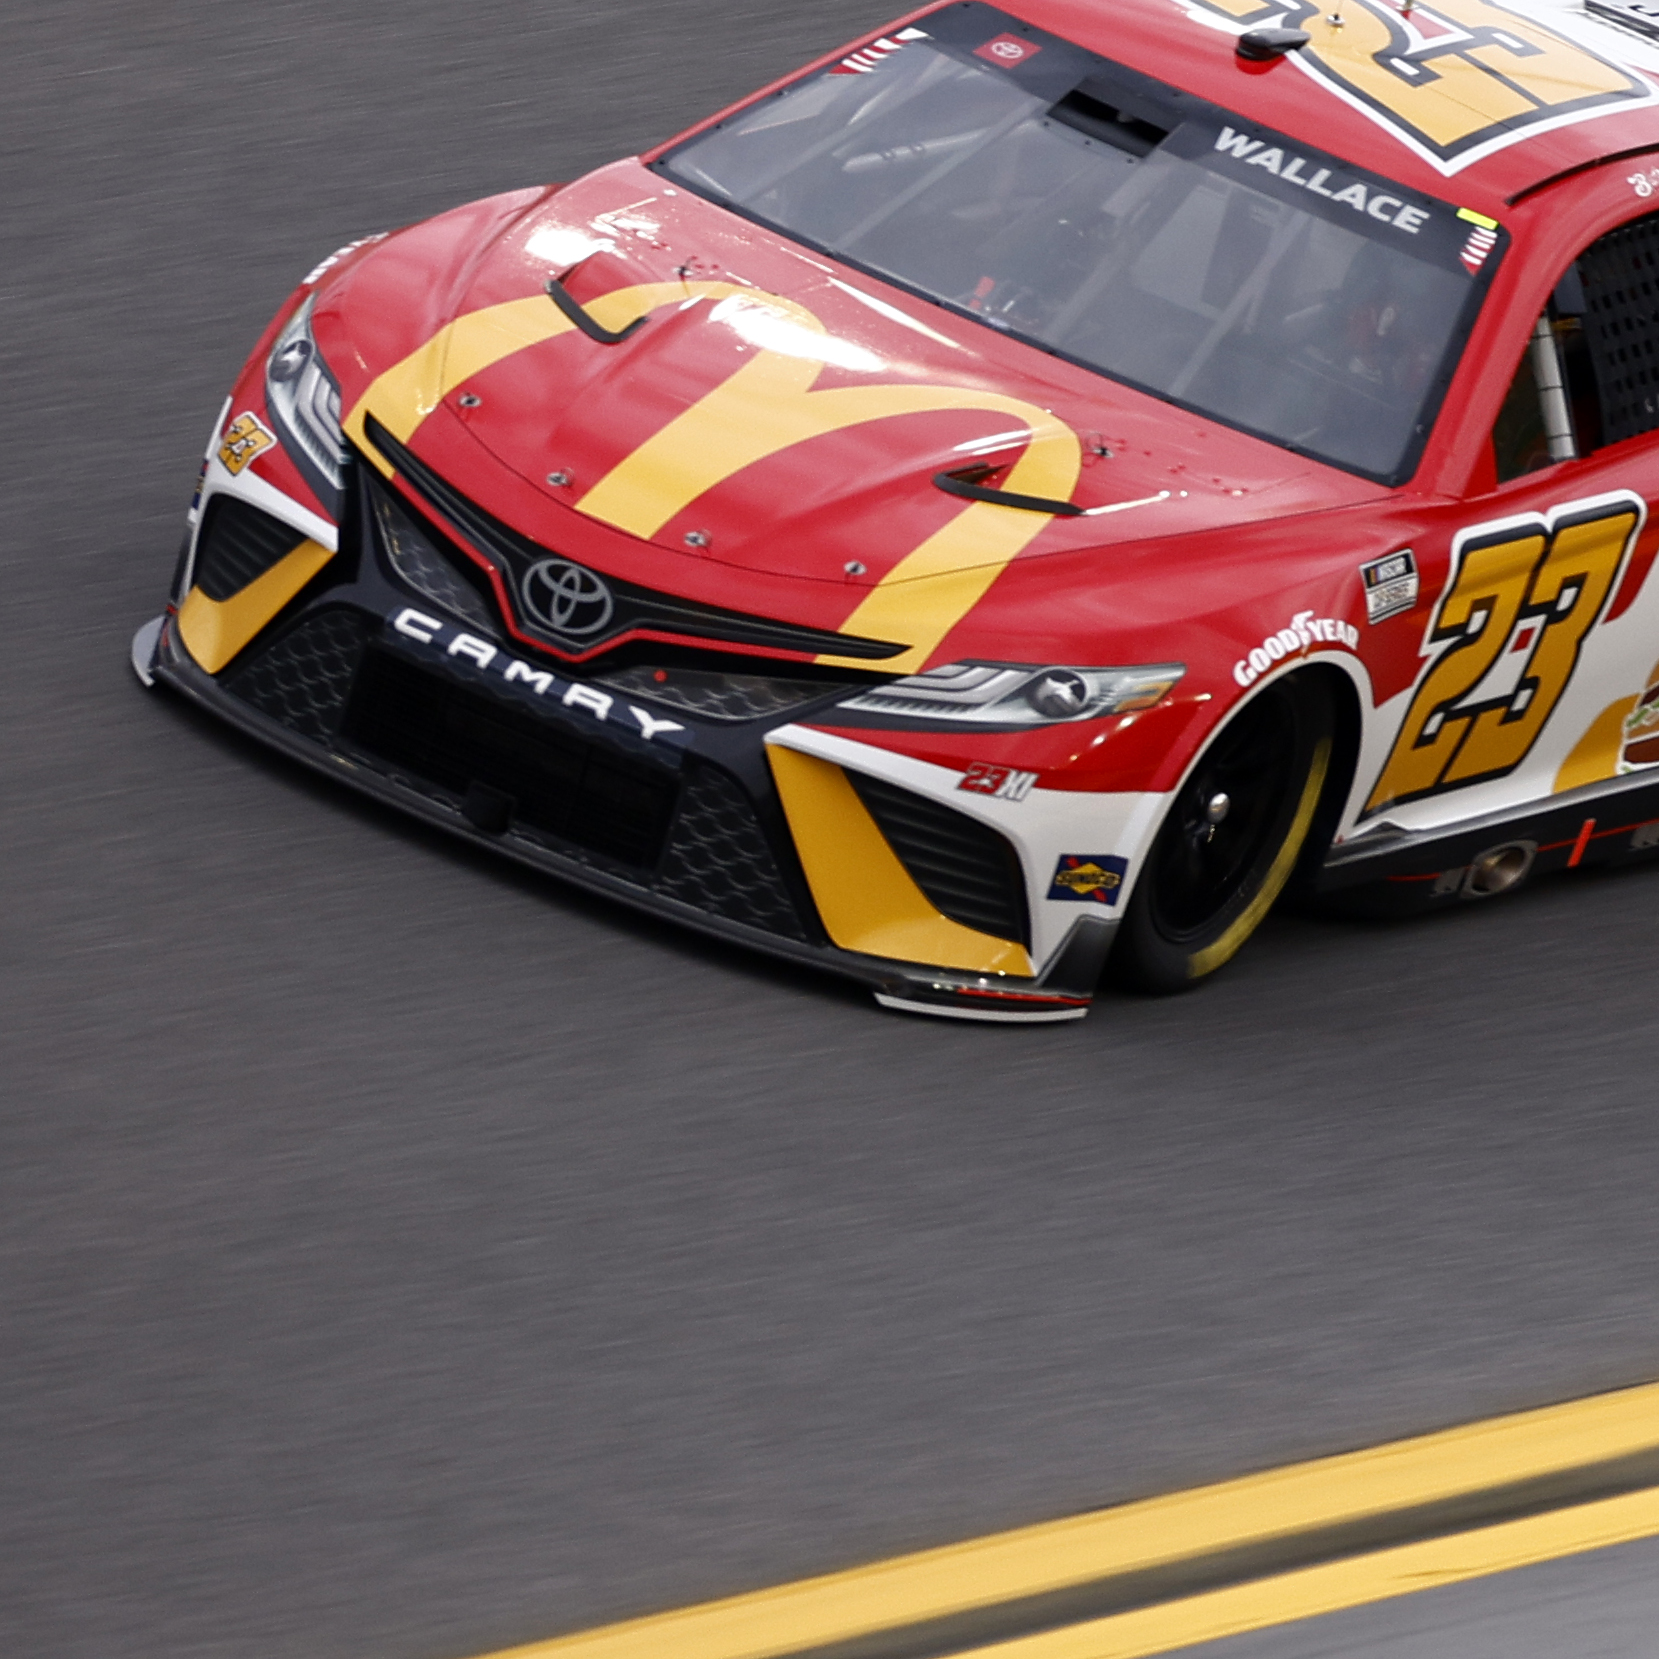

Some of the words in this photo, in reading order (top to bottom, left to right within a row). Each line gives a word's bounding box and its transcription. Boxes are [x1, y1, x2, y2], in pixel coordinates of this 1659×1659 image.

[1215, 125, 1430, 235] WALLACE
[394, 607, 685, 740] CAMRY
[1233, 609, 1359, 688] GOODYEAR
[1355, 491, 1647, 828] 23
